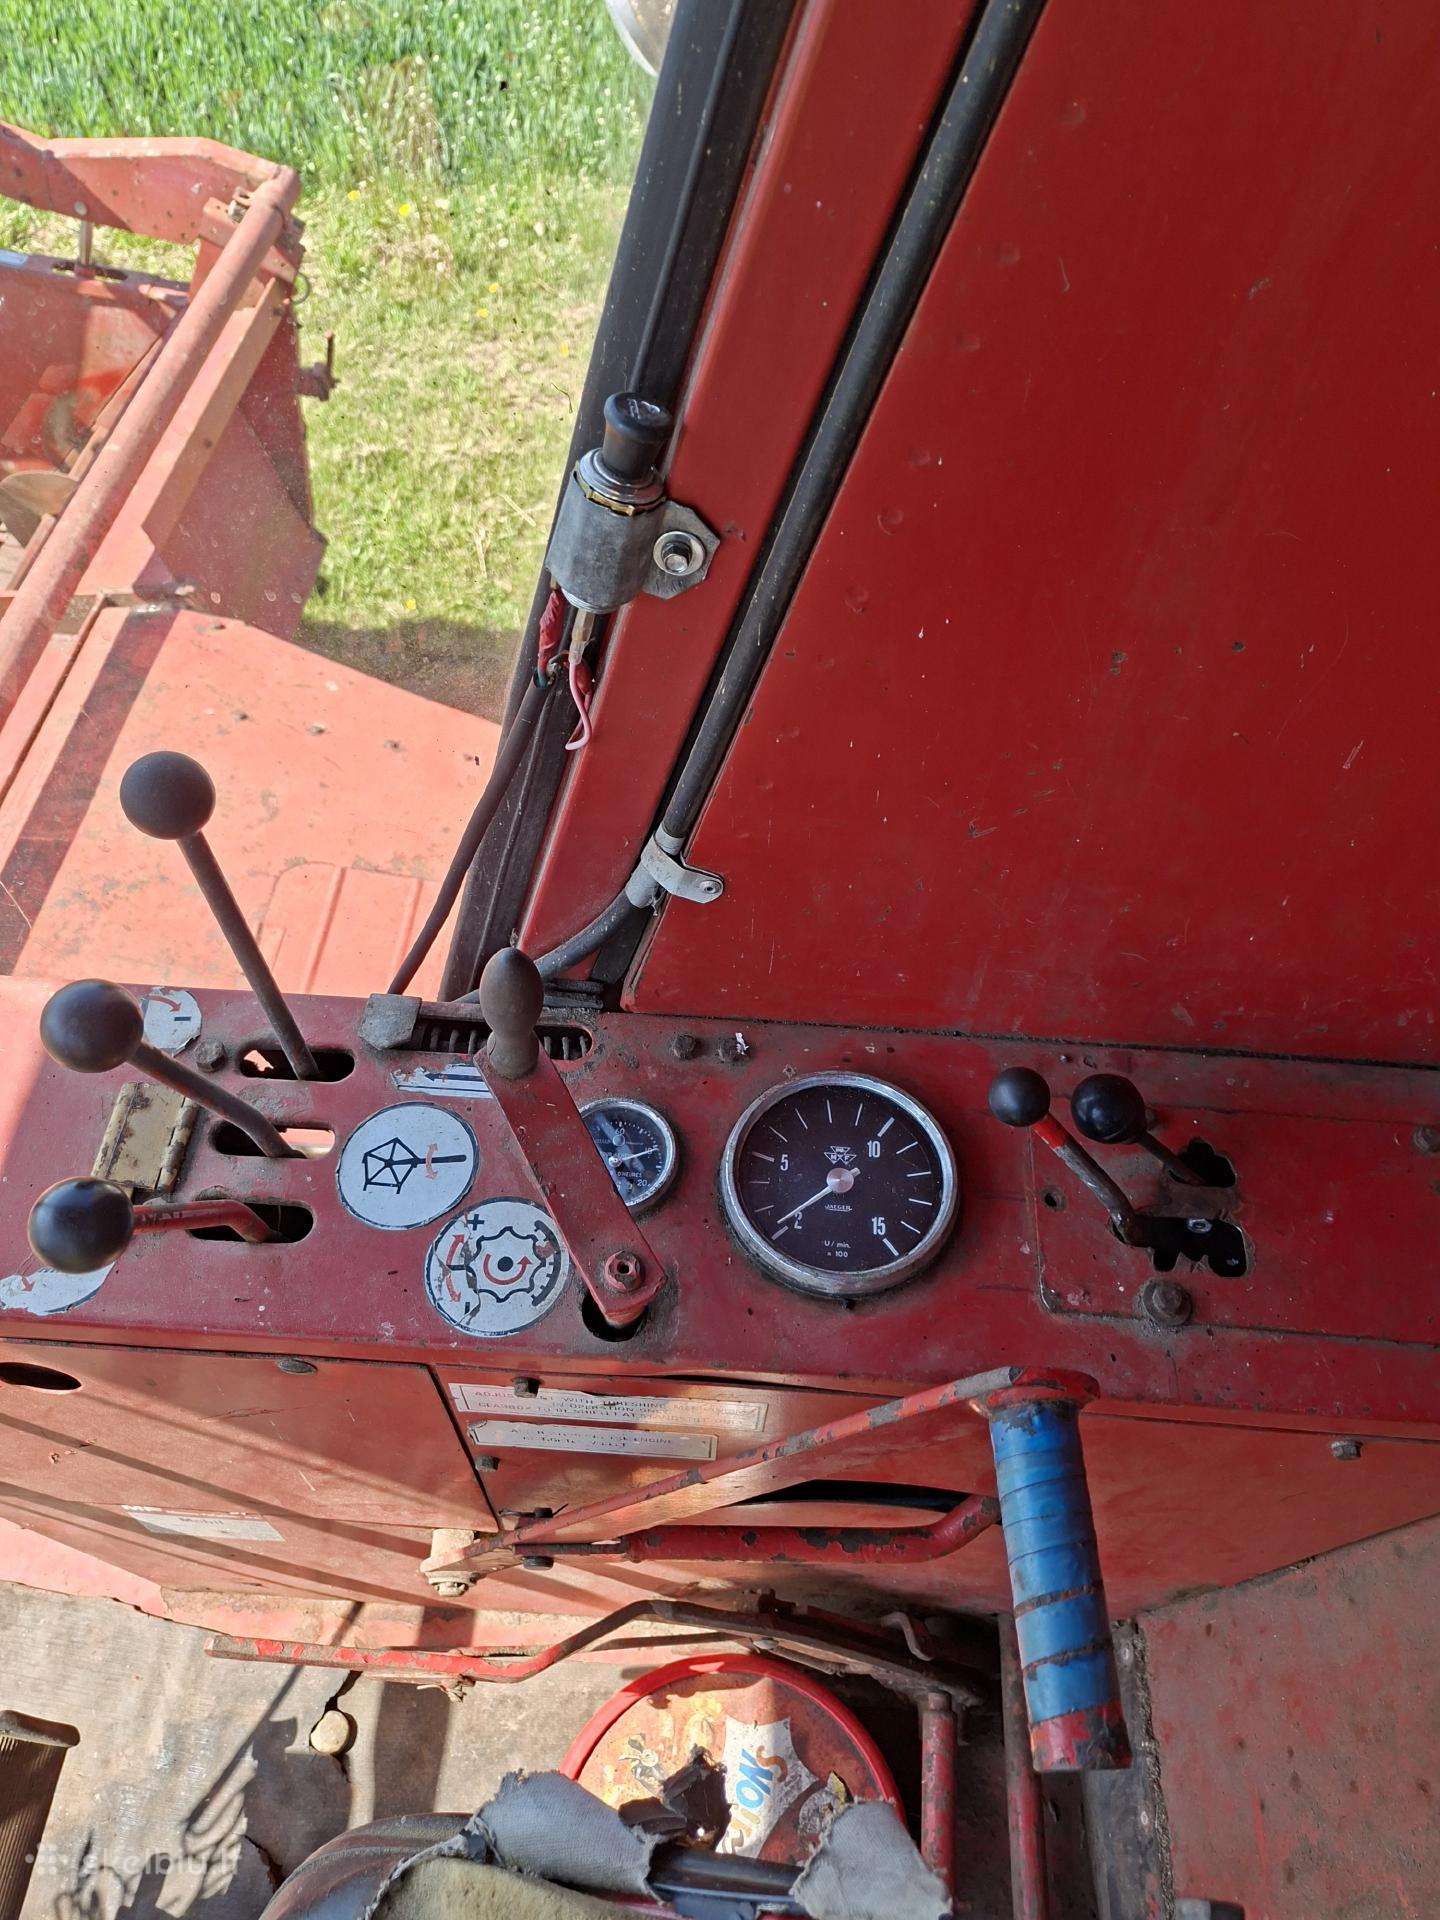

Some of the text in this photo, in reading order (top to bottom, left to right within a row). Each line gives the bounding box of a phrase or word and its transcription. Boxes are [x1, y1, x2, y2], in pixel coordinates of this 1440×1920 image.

[867, 1140, 881, 1158] 10
[780, 1154, 789, 1171] 5
[794, 1212, 803, 1230] 2
[871, 1216, 886, 1235] 15
